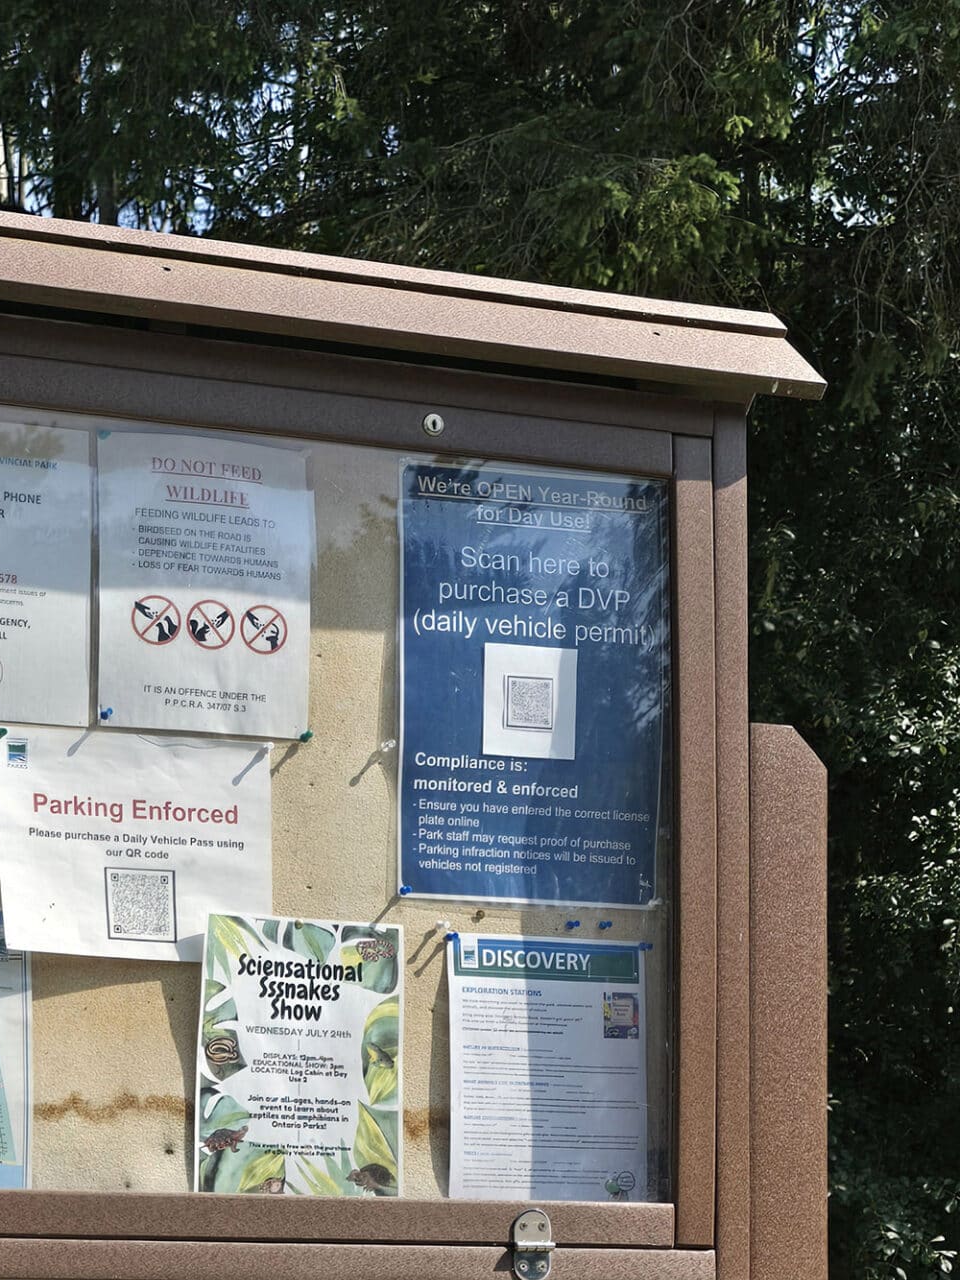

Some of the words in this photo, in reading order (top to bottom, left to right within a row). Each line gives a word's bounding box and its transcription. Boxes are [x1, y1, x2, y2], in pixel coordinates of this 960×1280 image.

[35, 457, 57, 469] PARK
[152, 457, 176, 471] DO
[181, 459, 216, 475] NOT
[221, 463, 261, 481] FEED
[4, 491, 41, 504] PHONE
[165, 485, 248, 505] WILDLIFE
[417, 475, 472, 496] We're
[478, 481, 531, 501] OPEN
[538, 486, 647, 511] Year-Round
[135, 508, 179, 519] FEEDING
[181, 512, 226, 523] WILDLIFE
[228, 516, 259, 527] LEADS
[262, 519, 275, 528] TO
[477, 504, 504, 522] for
[510, 508, 545, 528] Day
[550, 511, 590, 529] Use!
[138, 525, 181, 535] BIRDSEED
[199, 530, 215, 539] THE
[217, 531, 241, 541] ROAD
[243, 534, 251, 542] IS
[138, 536, 176, 546] CAUSING
[179, 540, 217, 550] WILDLIFE
[220, 543, 265, 555] FATALITIES
[138, 548, 196, 560] DEPENDENCE
[199, 553, 241, 564] TOWARDS
[243, 558, 278, 568] HUMANS
[461, 545, 519, 571] Scan
[529, 551, 580, 576] here
[589, 556, 610, 578] to
[138, 560, 160, 569] LOSS
[163, 562, 175, 570] OF
[177, 563, 199, 572] FEAR
[202, 565, 244, 576] TOWARDS
[246, 570, 281, 580] HUMANS
[439, 580, 548, 608] purchase
[556, 587, 569, 607] a
[579, 587, 630, 612] DVP
[413, 609, 477, 638] (daily
[485, 615, 566, 639] vehicle
[576, 622, 657, 651] permit)
[143, 684, 151, 692] IT
[178, 688, 216, 698] OFFENCE
[219, 691, 248, 700] UNDER
[250, 693, 266, 702] THE
[415, 752, 505, 771] Compliance
[511, 758, 528, 772] is:
[414, 777, 491, 792] monitored
[497, 780, 507, 793] &
[512, 782, 578, 798] enforced
[33, 793, 122, 823] Parking
[132, 799, 237, 824] Enforced
[419, 798, 456, 814] Ensure
[460, 803, 479, 813] you
[483, 802, 508, 813] have
[511, 805, 551, 816] entered
[555, 806, 571, 817] the
[574, 809, 609, 819] correct
[613, 810, 649, 821] license
[418, 814, 444, 826] plate
[447, 816, 480, 827] online
[29, 827, 61, 838] Please
[64, 832, 110, 841] purchase
[122, 833, 147, 845] Daily
[150, 835, 186, 845] Vehicle
[190, 837, 213, 847] Pass
[217, 839, 244, 850] using
[419, 828, 443, 843] Park
[446, 830, 469, 841] staff
[472, 834, 494, 845] may
[497, 835, 537, 846] request
[540, 836, 567, 847] proof
[570, 837, 580, 847] of
[583, 839, 630, 854] purchase
[125, 848, 141, 857] QR
[144, 851, 168, 859] code
[419, 843, 458, 858] Parking
[462, 844, 510, 858] infraction
[513, 849, 550, 860] notices
[554, 851, 569, 861] will
[573, 852, 586, 862] be
[589, 852, 624, 864] issued
[626, 856, 635, 865] to
[418, 858, 461, 870] vehicles
[465, 862, 481, 871] not
[485, 862, 536, 875] registered
[237, 954, 362, 982] Sciensational
[482, 949, 590, 970] DISCOVERY
[259, 978, 340, 1001] Sssnakes
[462, 986, 508, 994] EXPLORATION
[270, 999, 321, 1021] Show
[245, 1025, 303, 1035] WEDNESDAY
[305, 1029, 328, 1037] JULY
[330, 1030, 351, 1038] 24th
